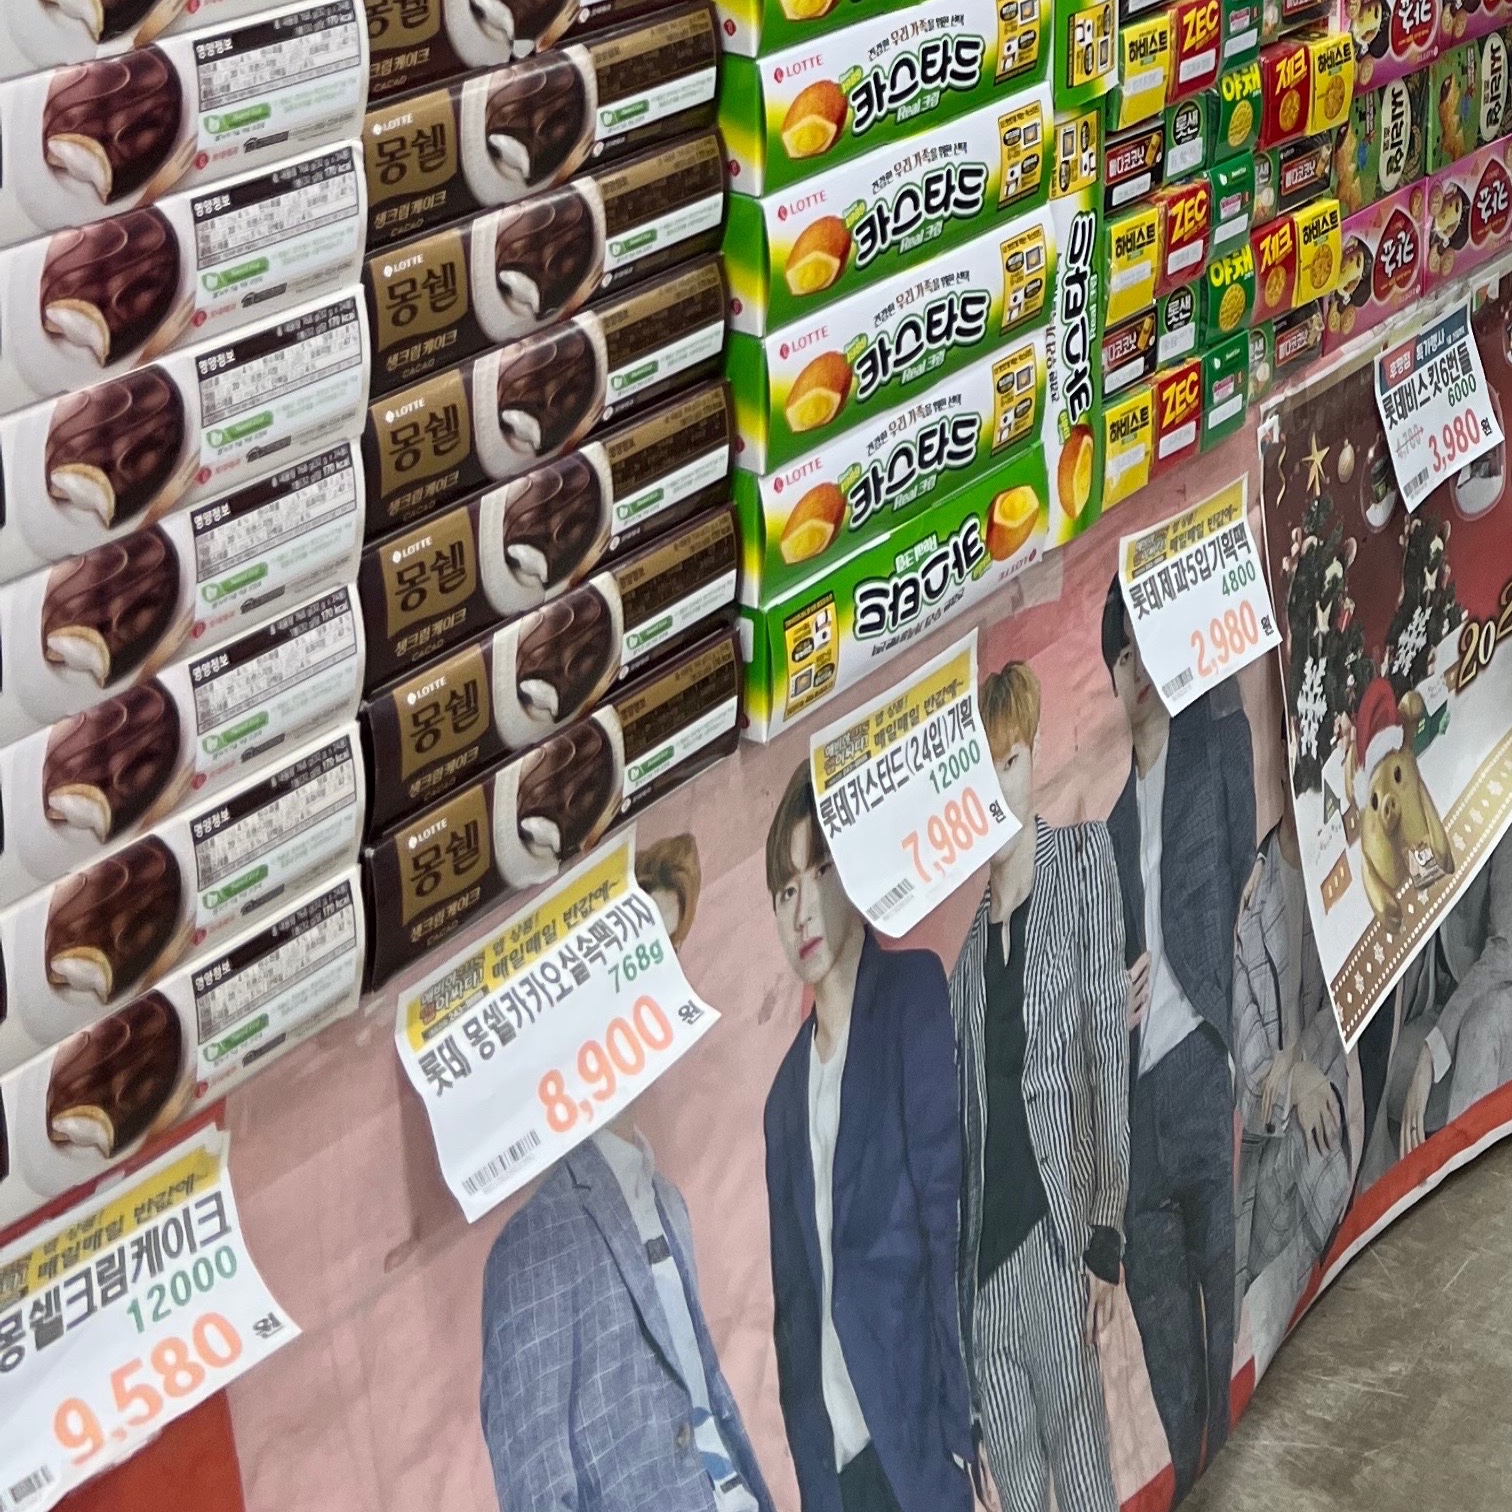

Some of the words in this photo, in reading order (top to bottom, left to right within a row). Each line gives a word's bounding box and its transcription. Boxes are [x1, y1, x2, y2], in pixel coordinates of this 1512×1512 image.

[1127, 34, 1169, 64] 하베스트
[1181, 0, 1220, 50] ZEC
[786, 54, 824, 77] LOTTE
[850, 33, 984, 134] 카스타드
[1220, 62, 1261, 101] 야채
[1274, 47, 1309, 95] 제크
[1316, 43, 1352, 76] 하베스트
[1173, 110, 1202, 137] 롯샌
[374, 124, 448, 186] 몽쉘
[790, 190, 827, 214] LOTTE
[853, 162, 988, 269] 카스타드
[1169, 192, 1208, 244] ZEC
[1114, 225, 1157, 258] 하베스트
[1259, 227, 1294, 271] 제크
[1301, 213, 1339, 247] 하베스트
[1209, 244, 1255, 289] 야채
[383, 264, 458, 327] 몽쉘
[1165, 296, 1193, 322] 롯샌
[853, 288, 991, 402] 카스타드
[1161, 375, 1201, 425] ZEC
[1381, 340, 1474, 431] 롯데비스킷6번들
[1446, 373, 1477, 409] 6000
[387, 410, 461, 473] 몽쉘
[1108, 410, 1150, 444] 하베스트
[1428, 407, 1482, 474] 3,980
[848, 412, 981, 530] 카스타드
[394, 541, 466, 607] 몽쉘
[1129, 521, 1253, 621] 롯데제과5입기획팩
[1221, 559, 1257, 598] 4800
[1190, 599, 1261, 680] 2,980
[409, 682, 481, 755] 몽쉘
[928, 738, 982, 795] 12000
[901, 785, 990, 886] 7,980
[491, 918, 559, 978] 매일매일
[607, 939, 666, 994] 768g
[418, 1033, 472, 1098] 롯데
[462, 892, 656, 1062] 몽쉘카카오실속팩키지
[536, 994, 674, 1133] 8,900
[677, 999, 705, 1026] 원
[127, 1244, 239, 1335] 12000
[252, 1312, 286, 1340] 원
